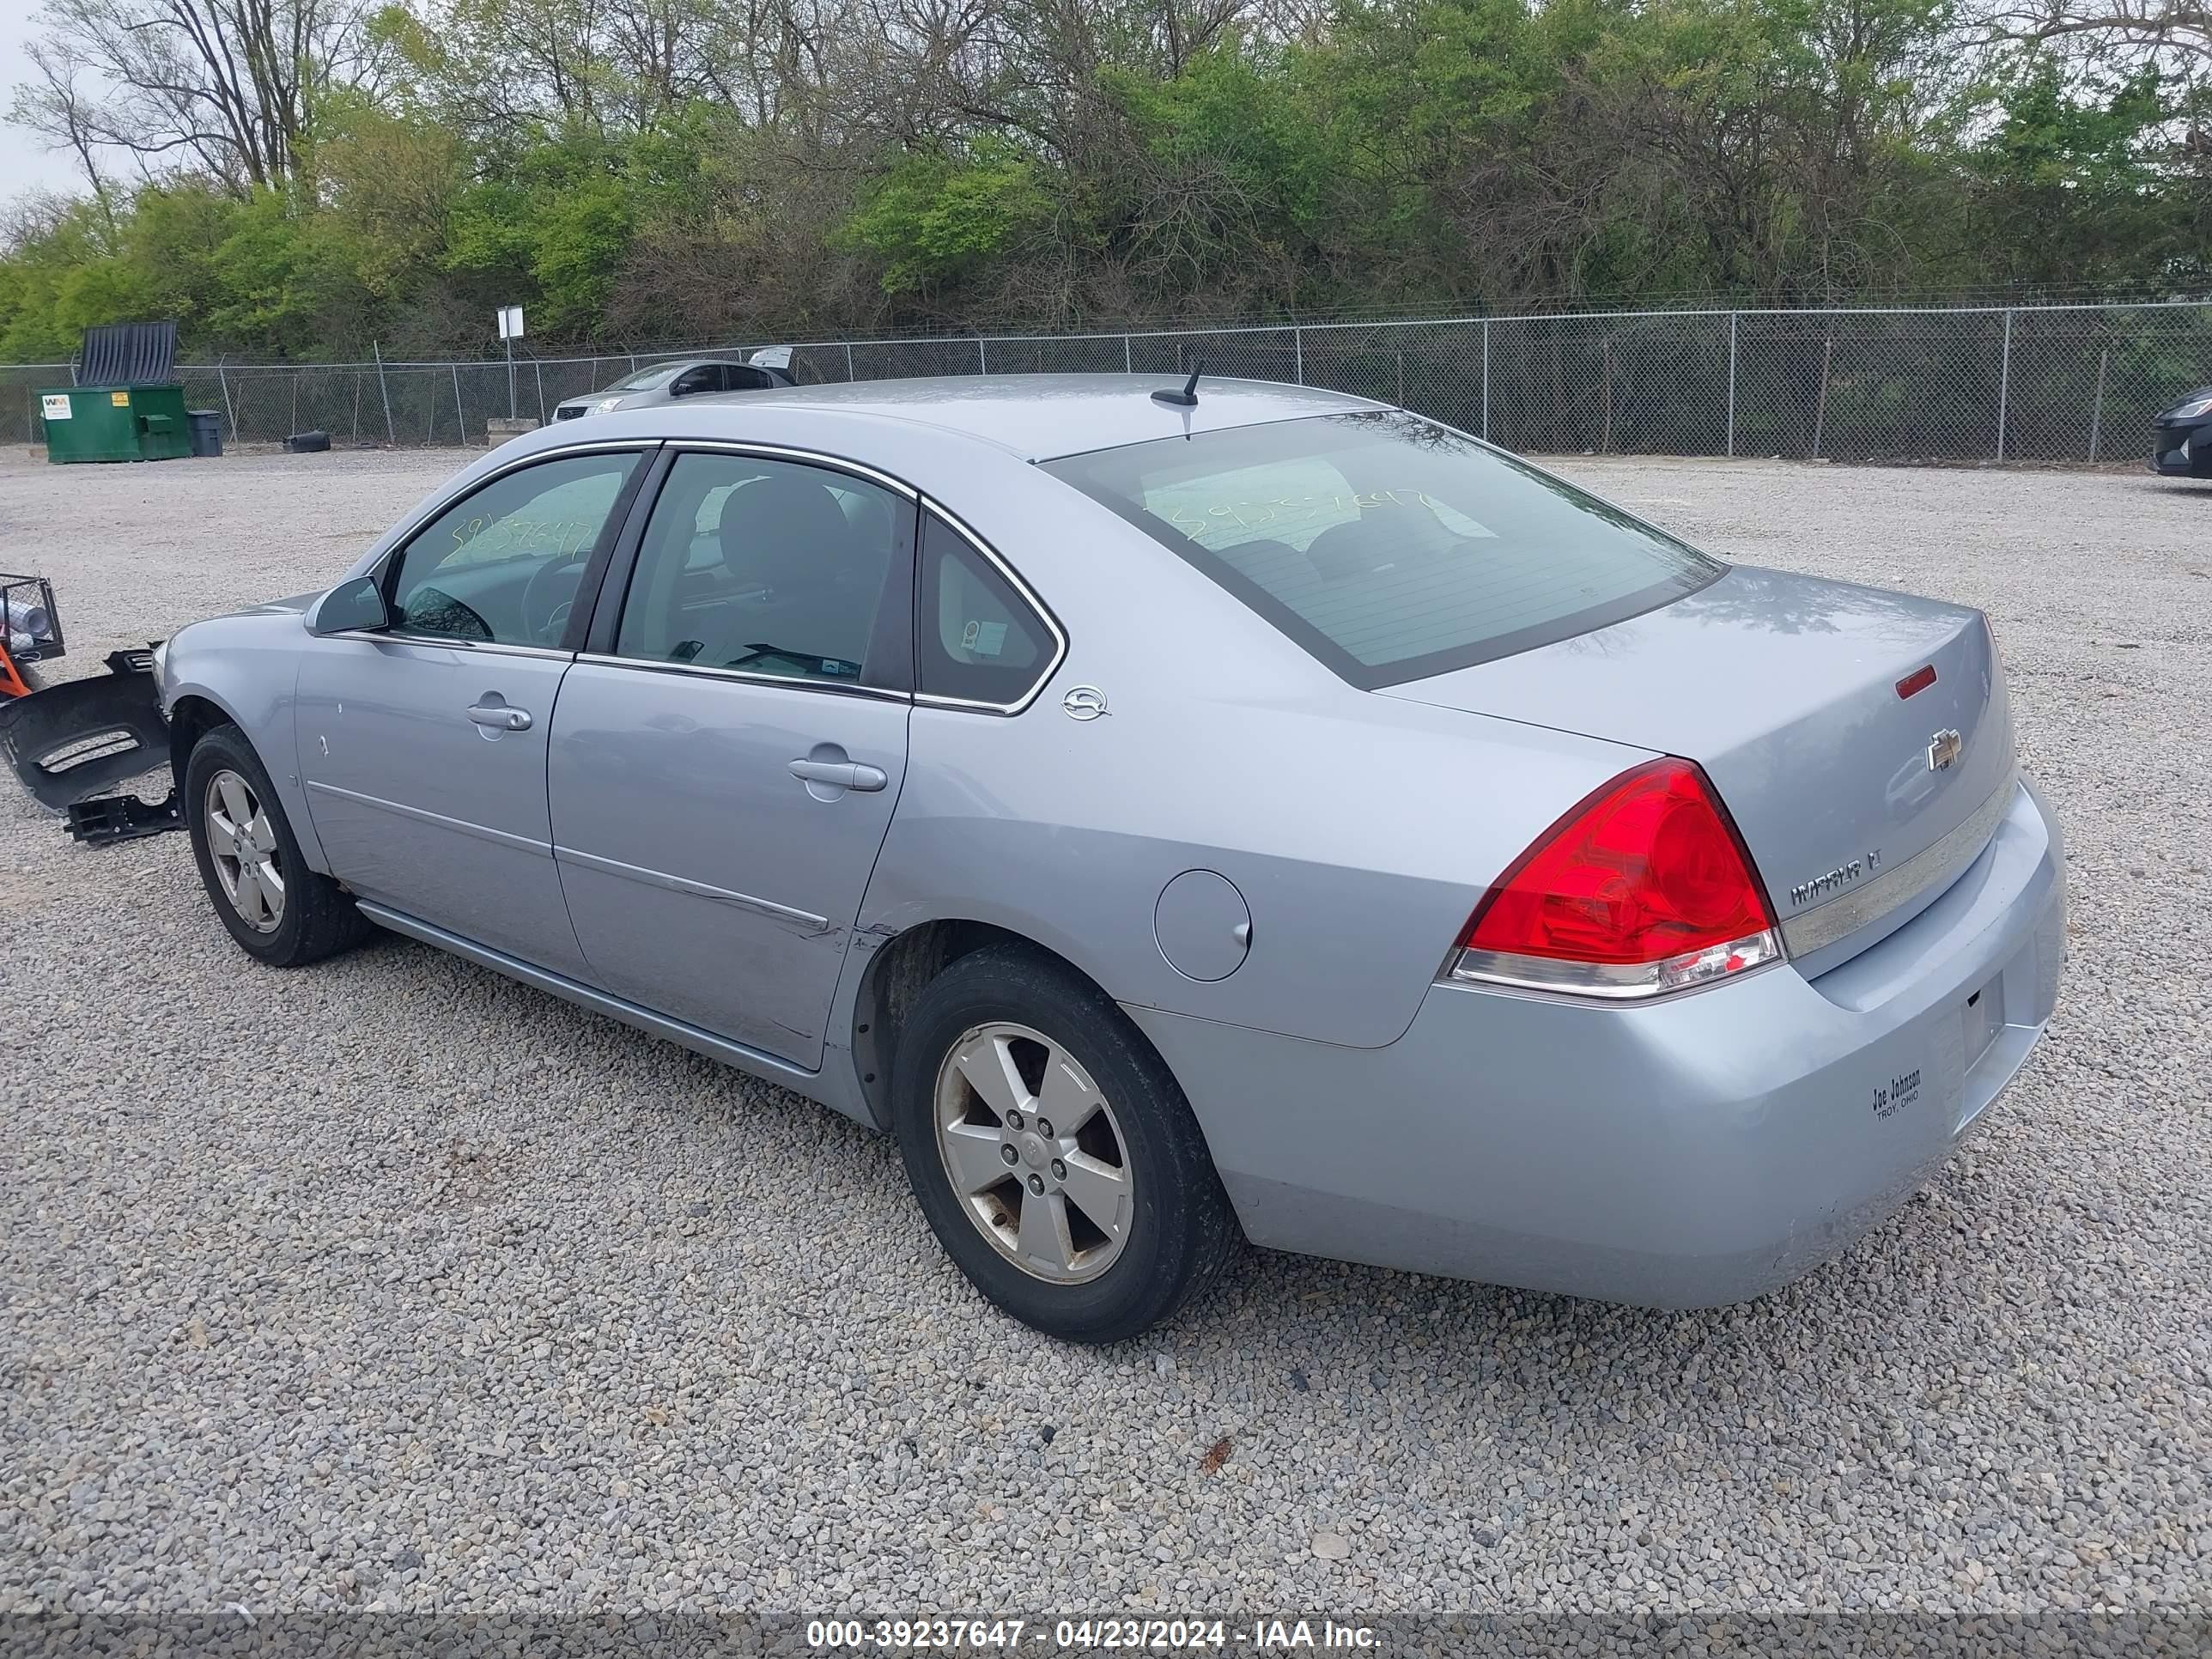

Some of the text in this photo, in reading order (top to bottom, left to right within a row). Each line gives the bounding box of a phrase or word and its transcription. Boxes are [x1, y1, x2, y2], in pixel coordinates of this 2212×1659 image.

[45, 398, 68, 406] WM
[1790, 848, 1882, 907] IMPALA LT
[1873, 1069, 1921, 1111] Joe Johnson
[1877, 1090, 1919, 1122] TROY, OHIO
